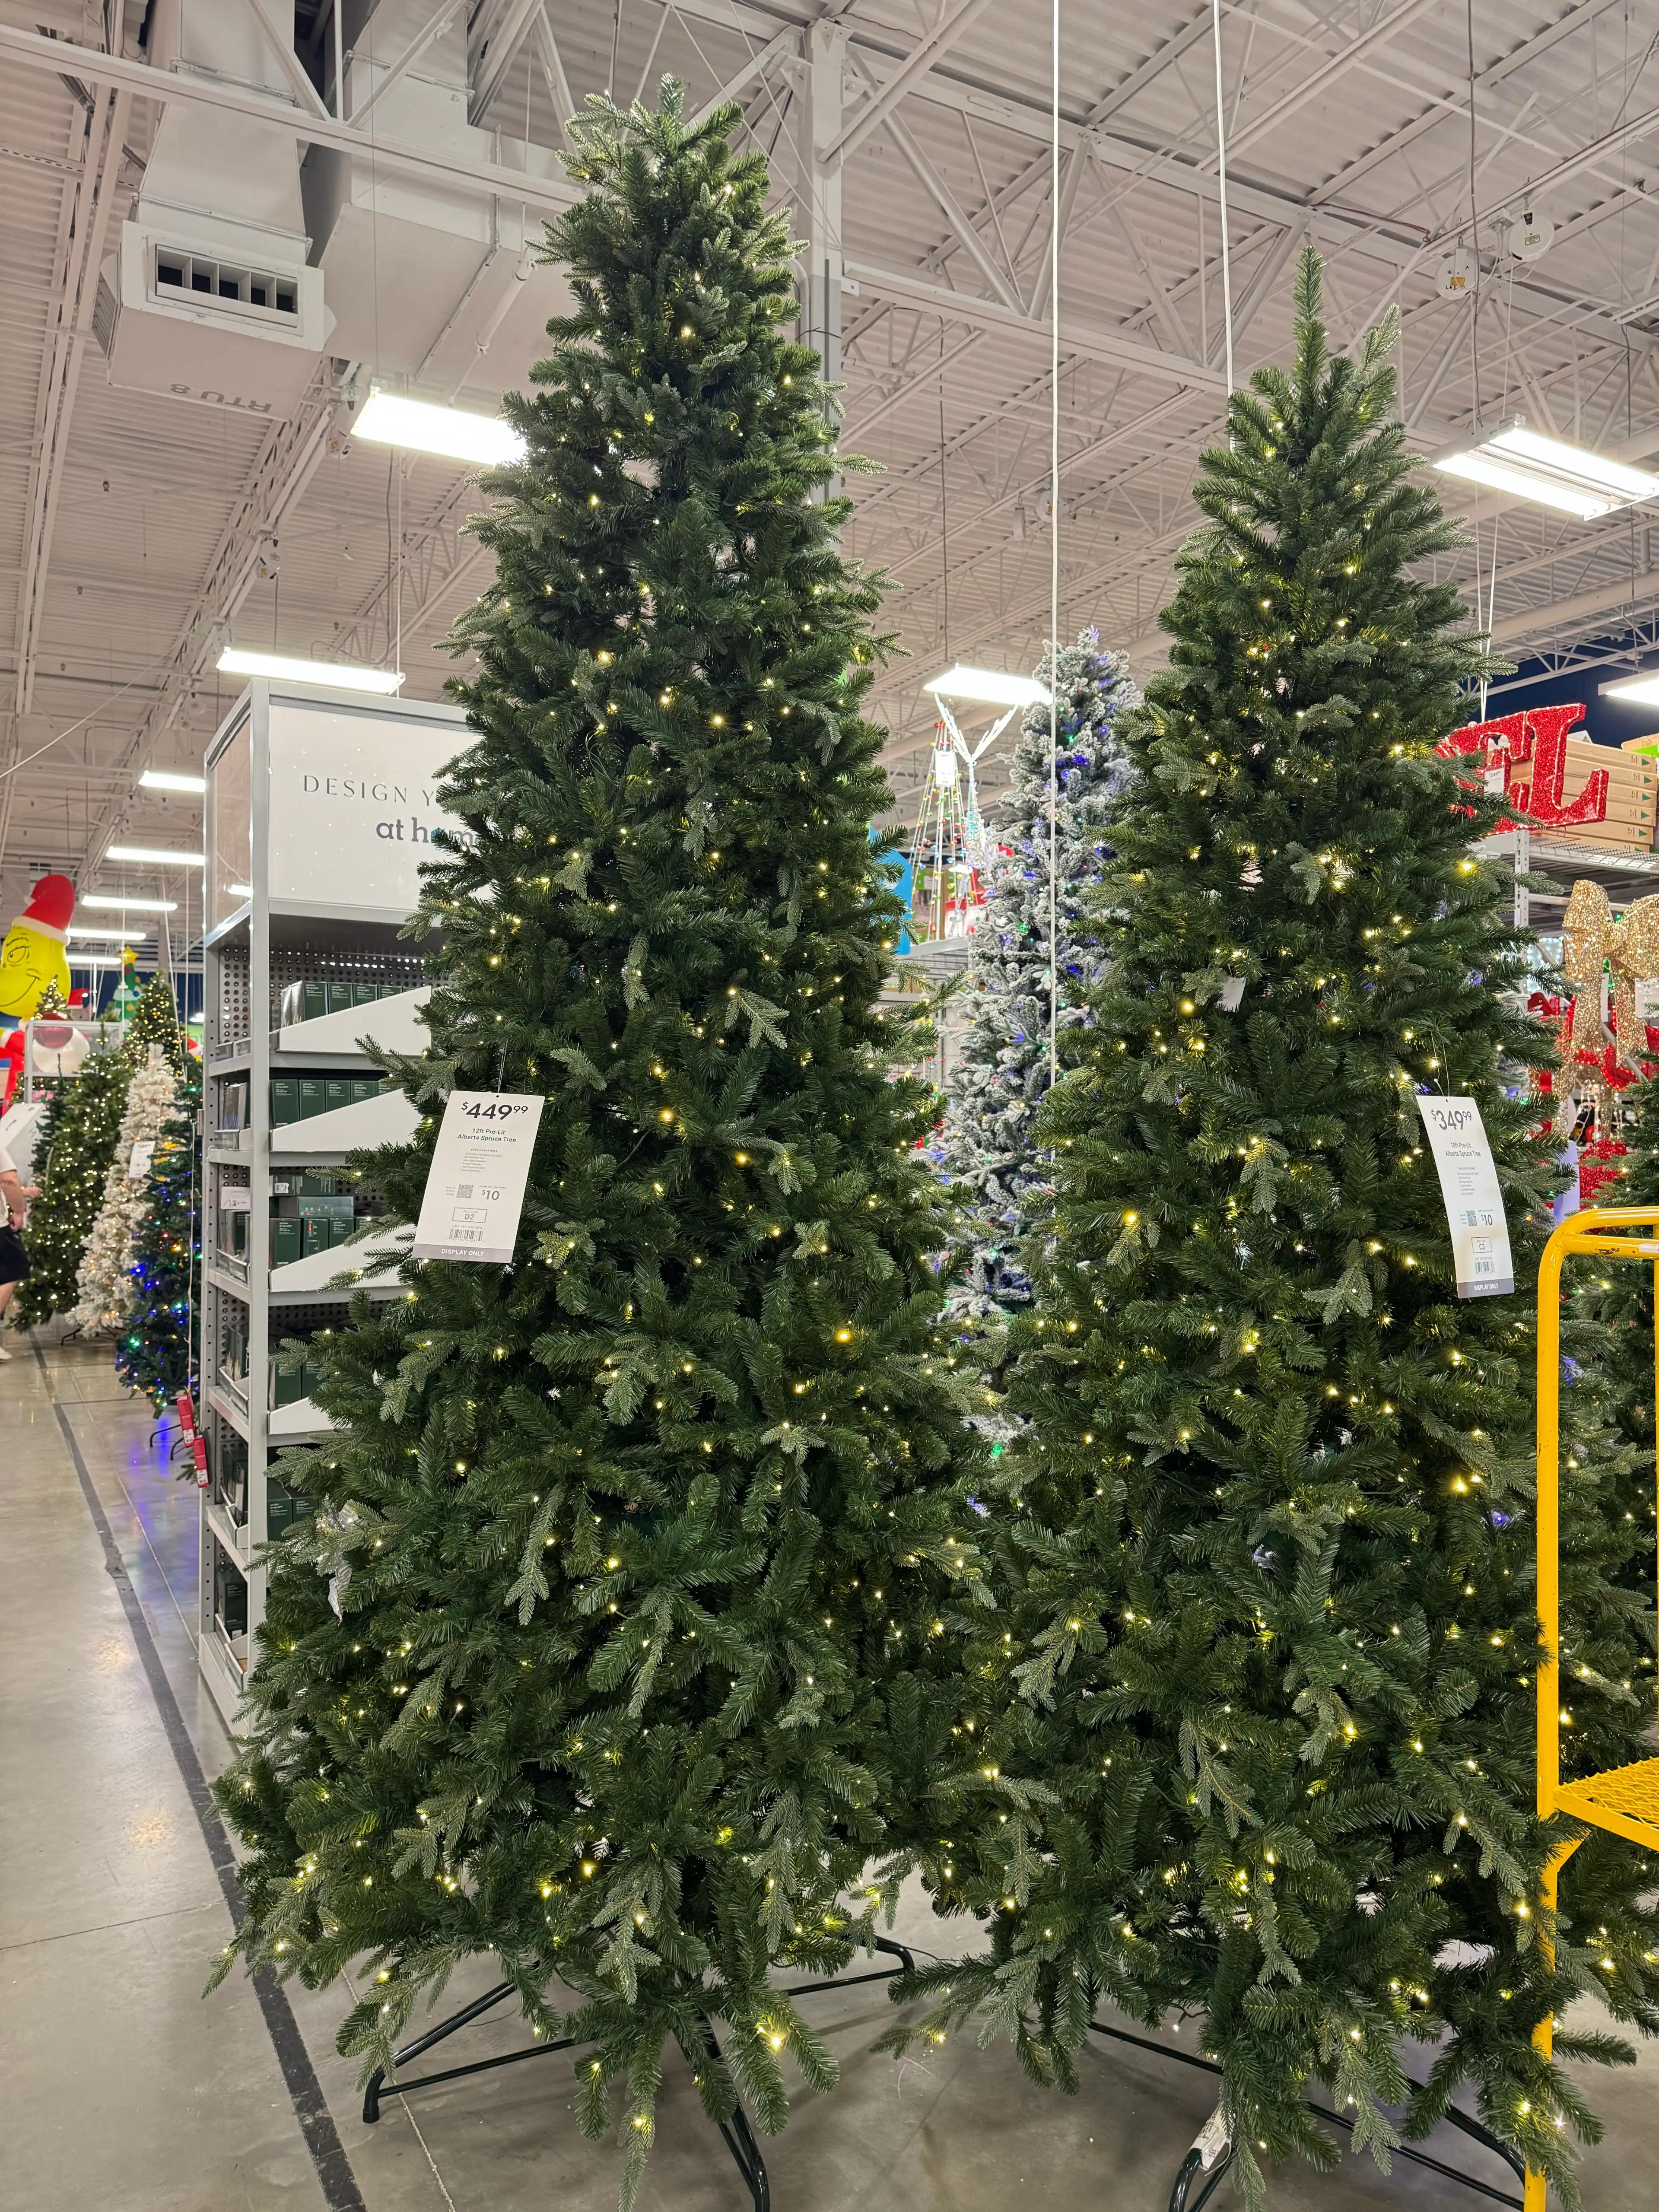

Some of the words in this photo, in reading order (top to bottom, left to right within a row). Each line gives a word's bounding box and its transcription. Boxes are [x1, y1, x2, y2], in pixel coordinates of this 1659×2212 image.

[170, 383, 191, 394] 8
[200, 391, 272, 413] RTU
[304, 775, 407, 804] DESIGN
[376, 819, 404, 841] at
[411, 817, 477, 846] hm
[482, 1189, 500, 1201] $10
[1481, 1214, 1493, 1226] $10
